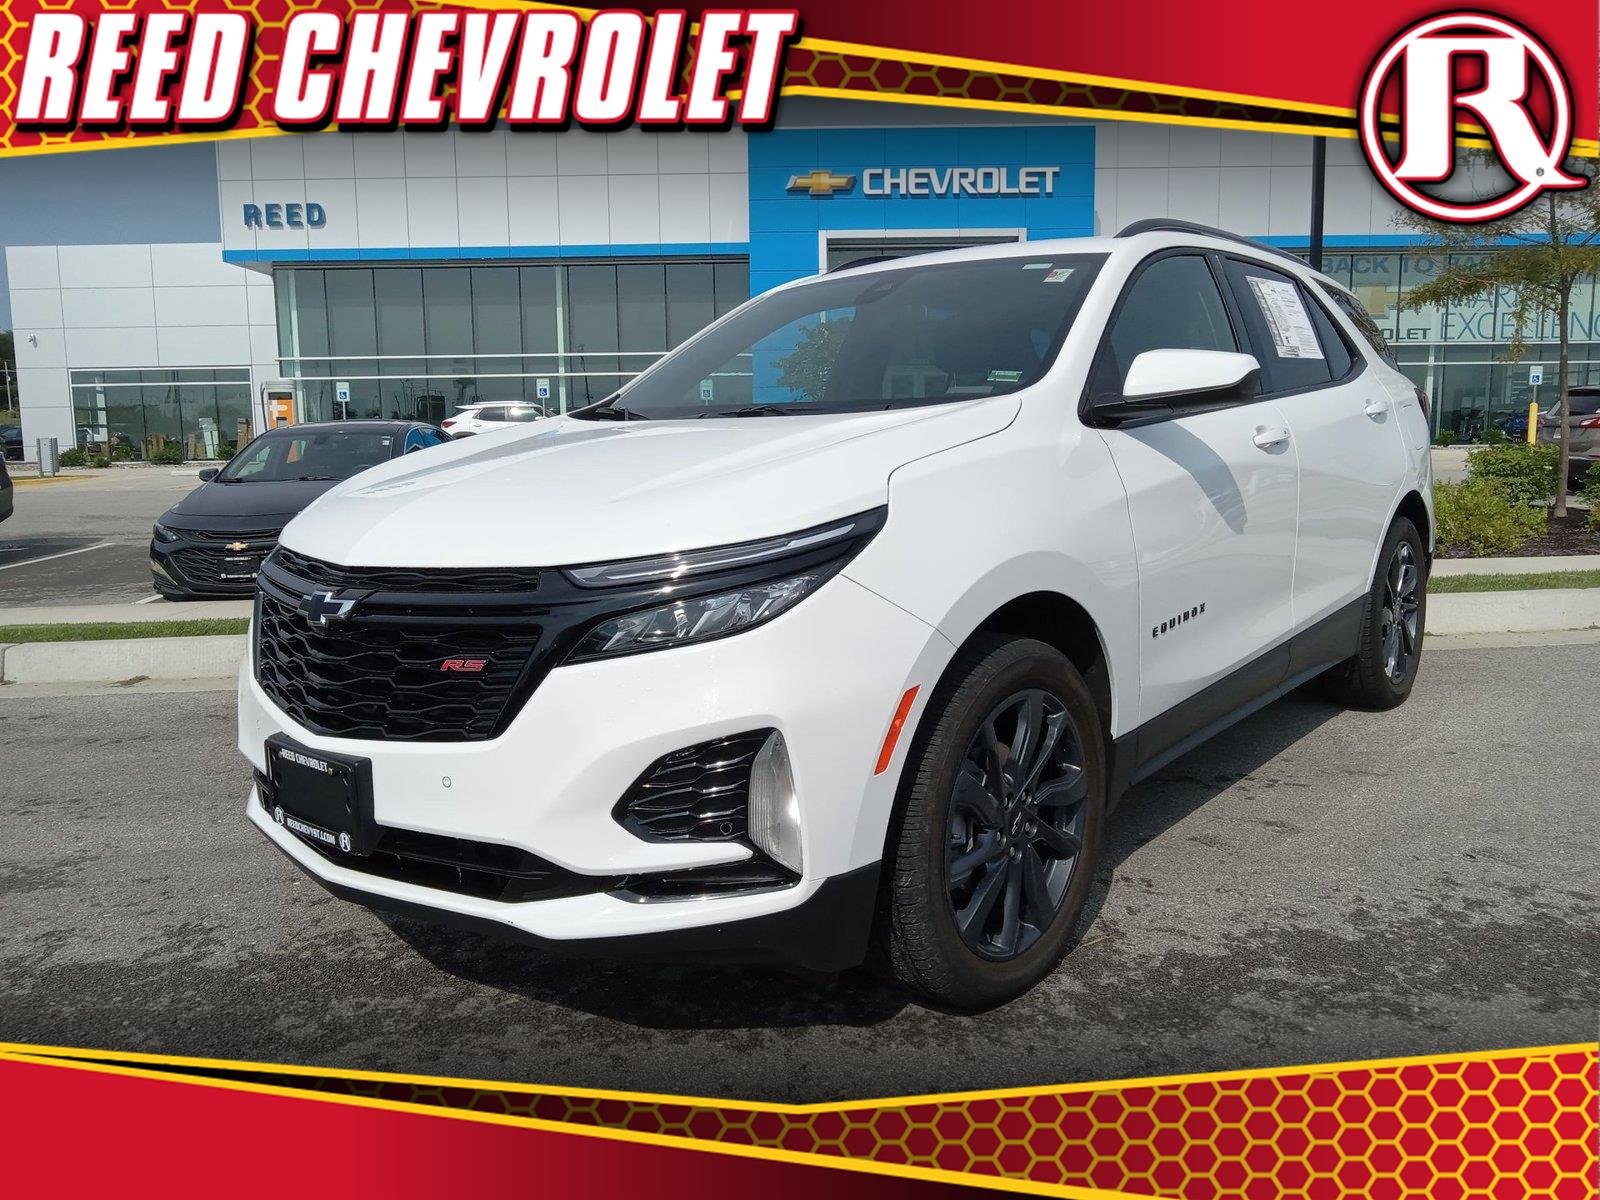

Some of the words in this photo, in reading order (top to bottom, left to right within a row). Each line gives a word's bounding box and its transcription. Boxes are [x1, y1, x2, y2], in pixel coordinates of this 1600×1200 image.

[862, 166, 1060, 196] CHEVROLET
[243, 202, 326, 230] REED
[1152, 602, 1206, 638] EQUINOX
[440, 659, 487, 672] RS
[295, 753, 328, 773] CHEVROLET
